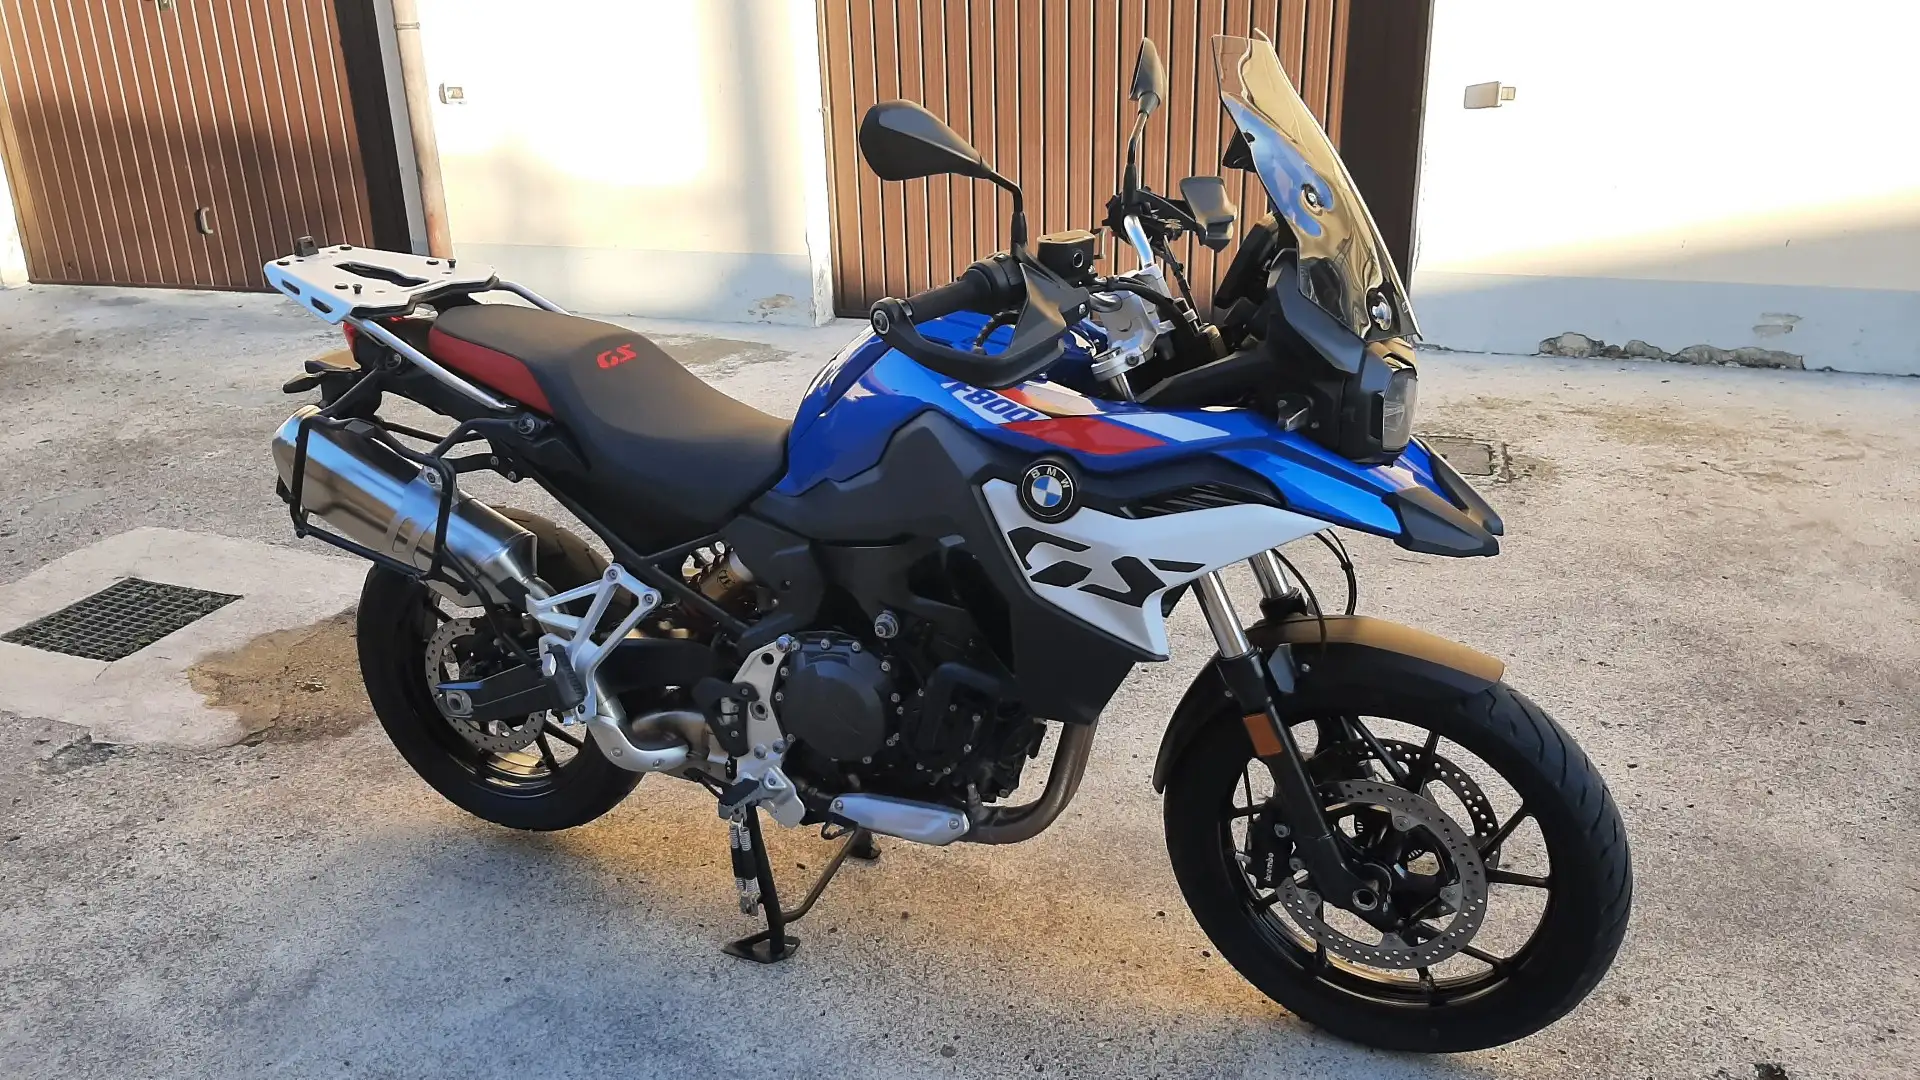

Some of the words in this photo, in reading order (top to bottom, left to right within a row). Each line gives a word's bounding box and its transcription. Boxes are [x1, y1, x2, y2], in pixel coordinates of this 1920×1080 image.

[597, 343, 637, 368] GS
[1030, 467, 1070, 489] BMW
[1007, 526, 1206, 609] GS
[1264, 852, 1275, 882] brembo
